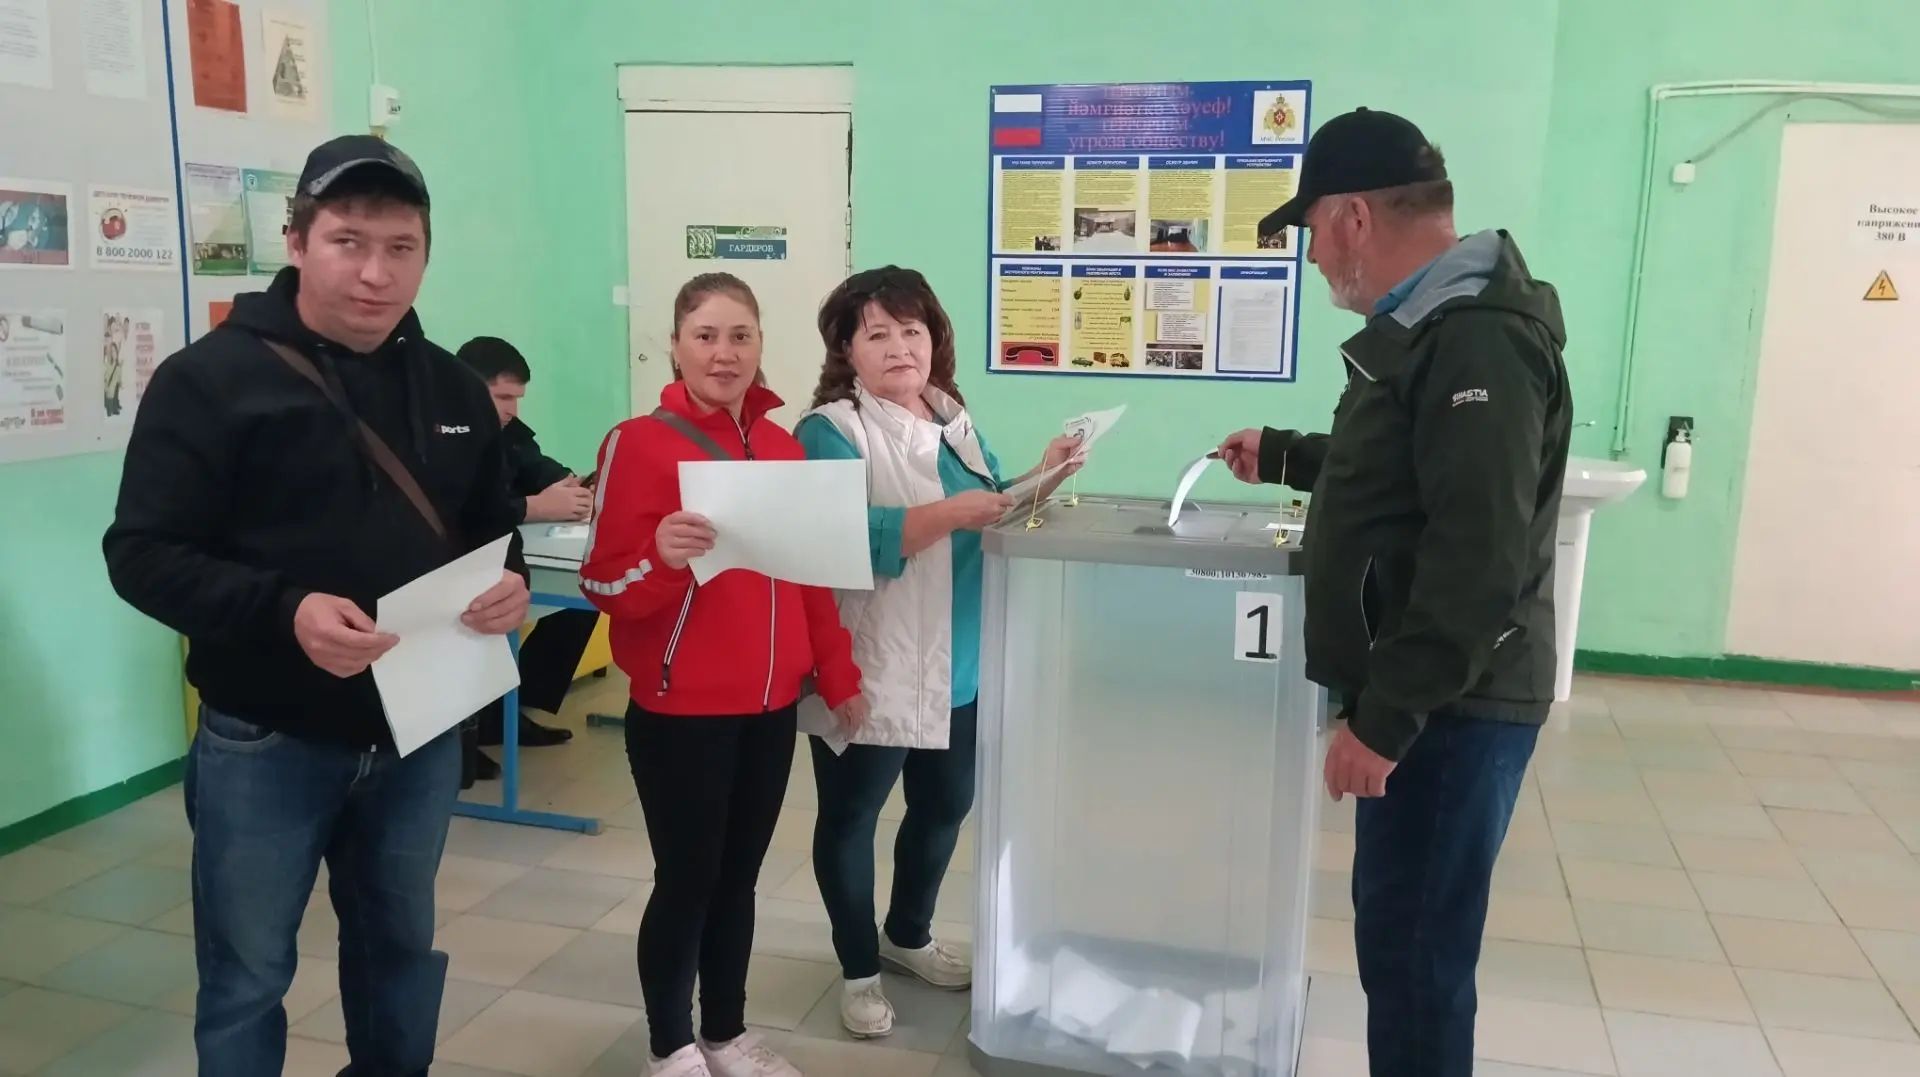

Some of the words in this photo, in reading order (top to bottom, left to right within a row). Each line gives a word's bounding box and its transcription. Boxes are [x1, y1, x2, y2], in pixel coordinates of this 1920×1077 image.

[1869, 203, 1919, 215] Высокое
[1874, 231, 1895, 241] 380
[106, 246, 125, 257] 800
[128, 247, 153, 258] 2000
[1245, 604, 1277, 660] 1
